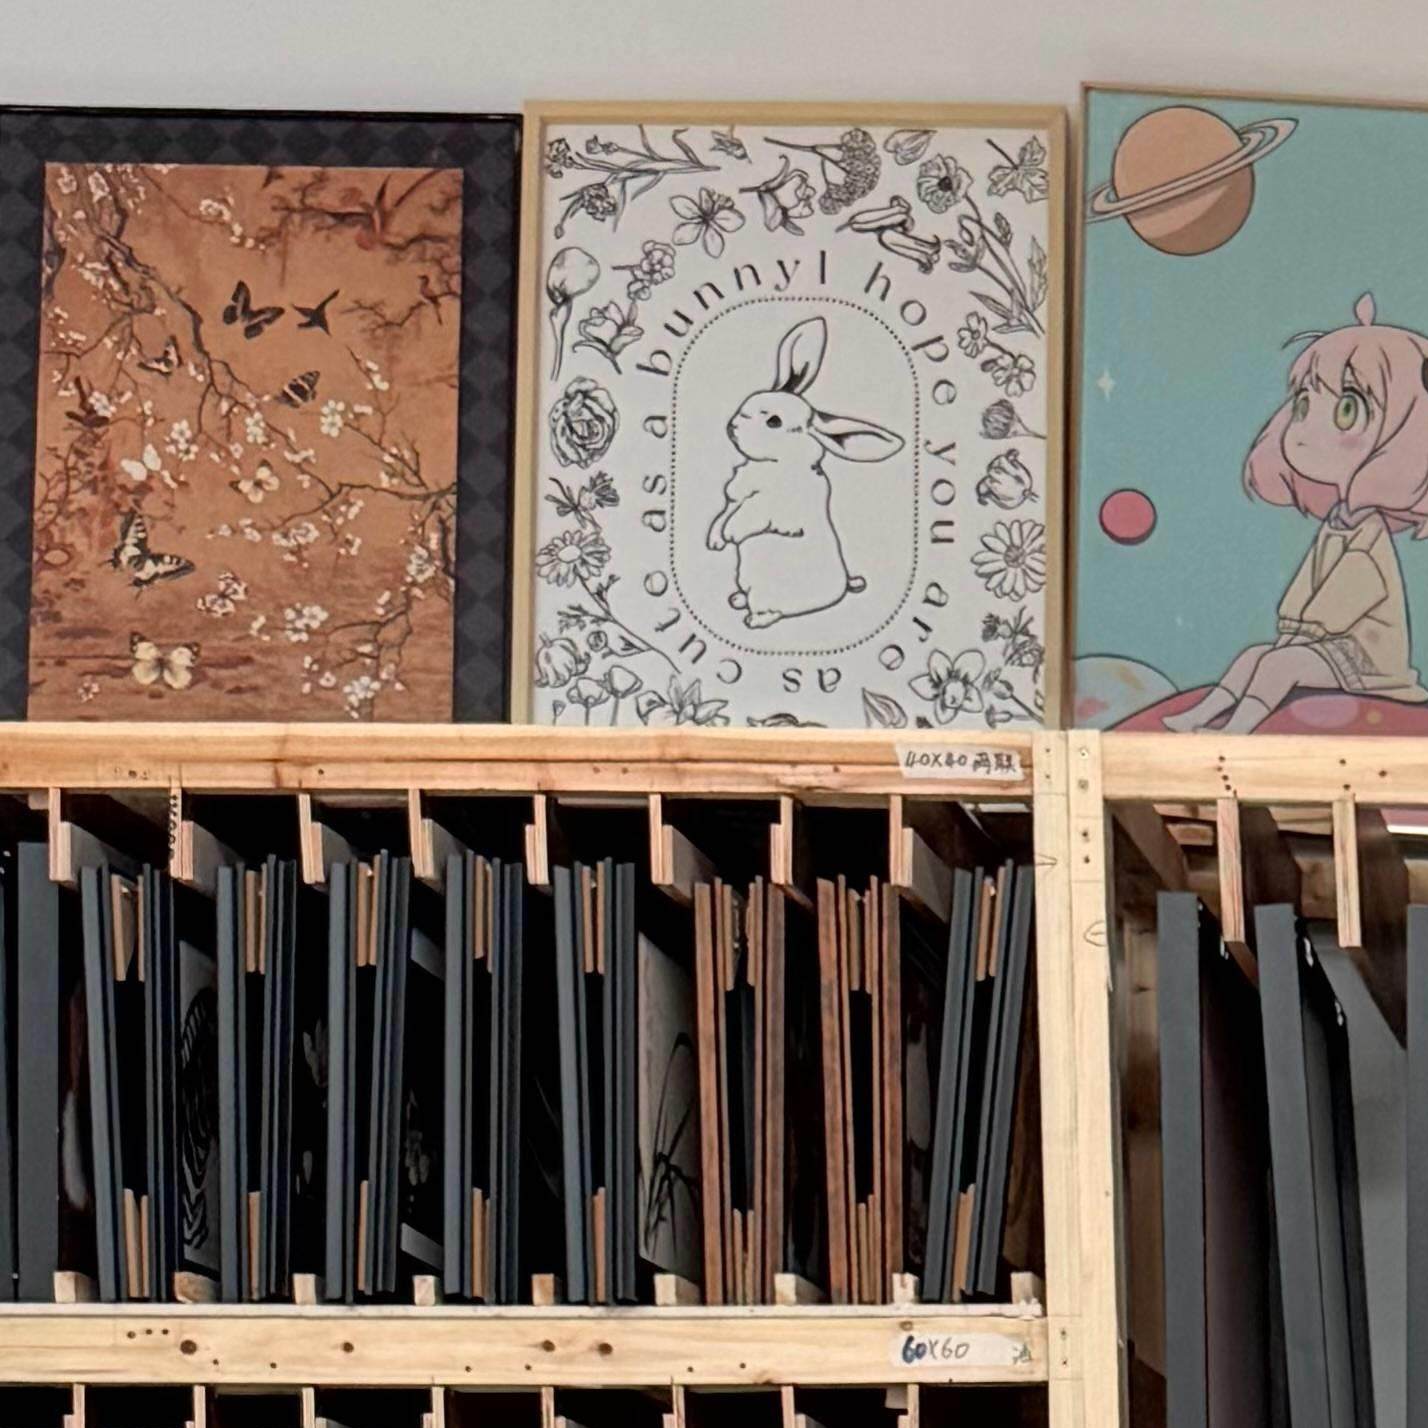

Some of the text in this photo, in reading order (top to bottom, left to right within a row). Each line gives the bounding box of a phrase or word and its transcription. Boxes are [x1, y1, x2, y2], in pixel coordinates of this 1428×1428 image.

[636, 259, 799, 377] bunny
[863, 261, 957, 406] hope
[642, 413, 668, 439] a
[640, 472, 668, 533] as
[925, 438, 956, 545] you
[642, 570, 744, 684] cute
[877, 581, 949, 671] are
[781, 665, 841, 693] as
